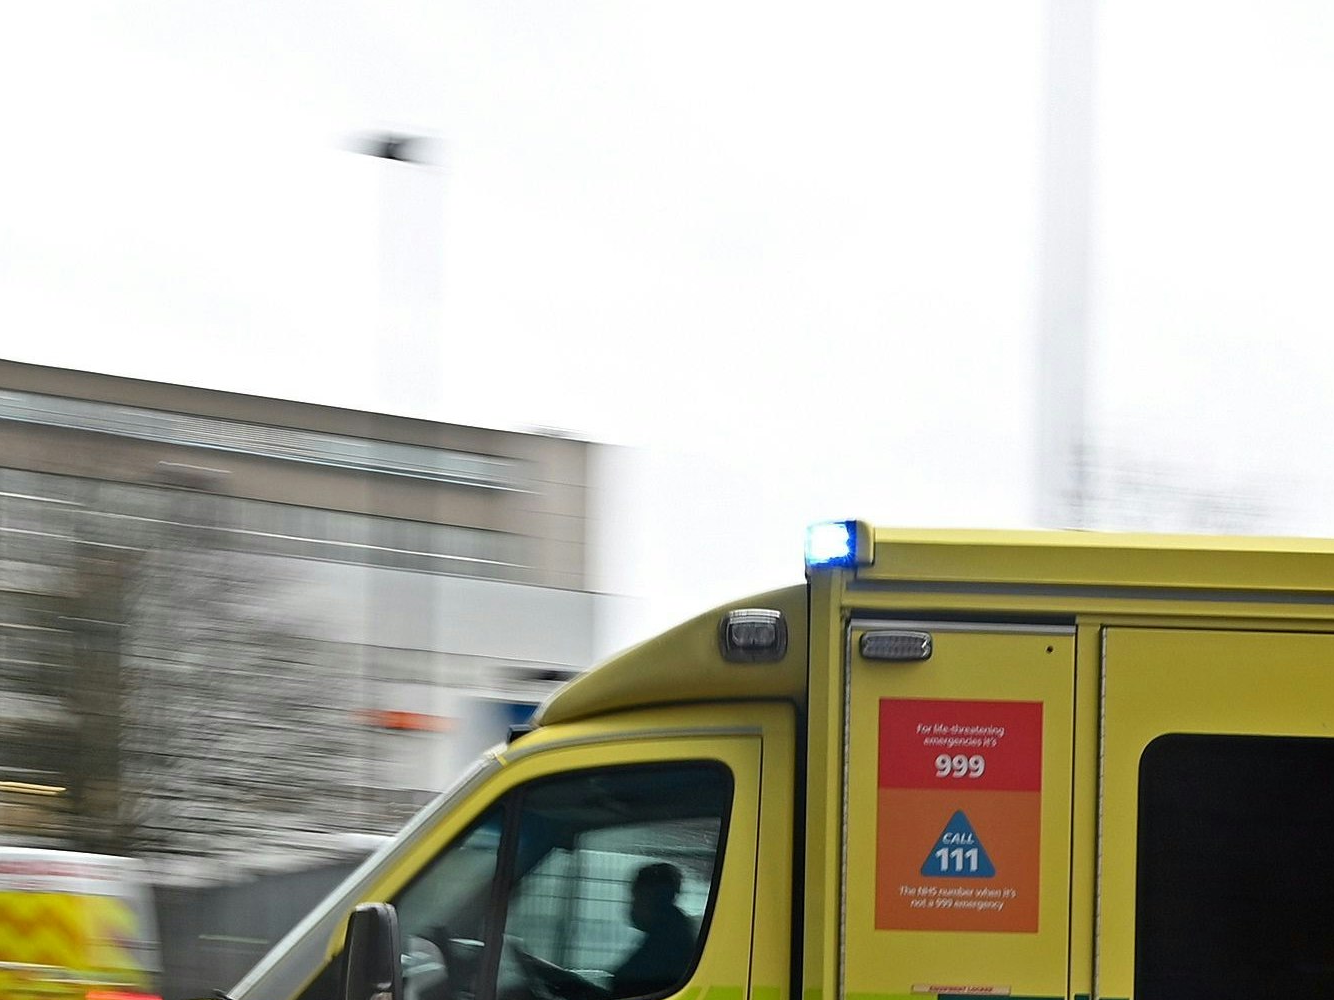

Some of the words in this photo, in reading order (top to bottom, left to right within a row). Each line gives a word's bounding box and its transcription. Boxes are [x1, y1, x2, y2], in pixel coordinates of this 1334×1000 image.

[916, 723, 932, 734] For
[933, 723, 1005, 738] life-threatening
[923, 736, 982, 748] emergencies
[935, 753, 985, 778] 999
[942, 832, 975, 845] CALL
[935, 847, 979, 872] 111
[899, 885, 916, 896] The
[917, 886, 938, 897] NHS
[938, 886, 974, 897] number
[975, 887, 1001, 898] when
[910, 898, 927, 908] not
[935, 898, 953, 909] 999
[954, 901, 1004, 911] emergency
